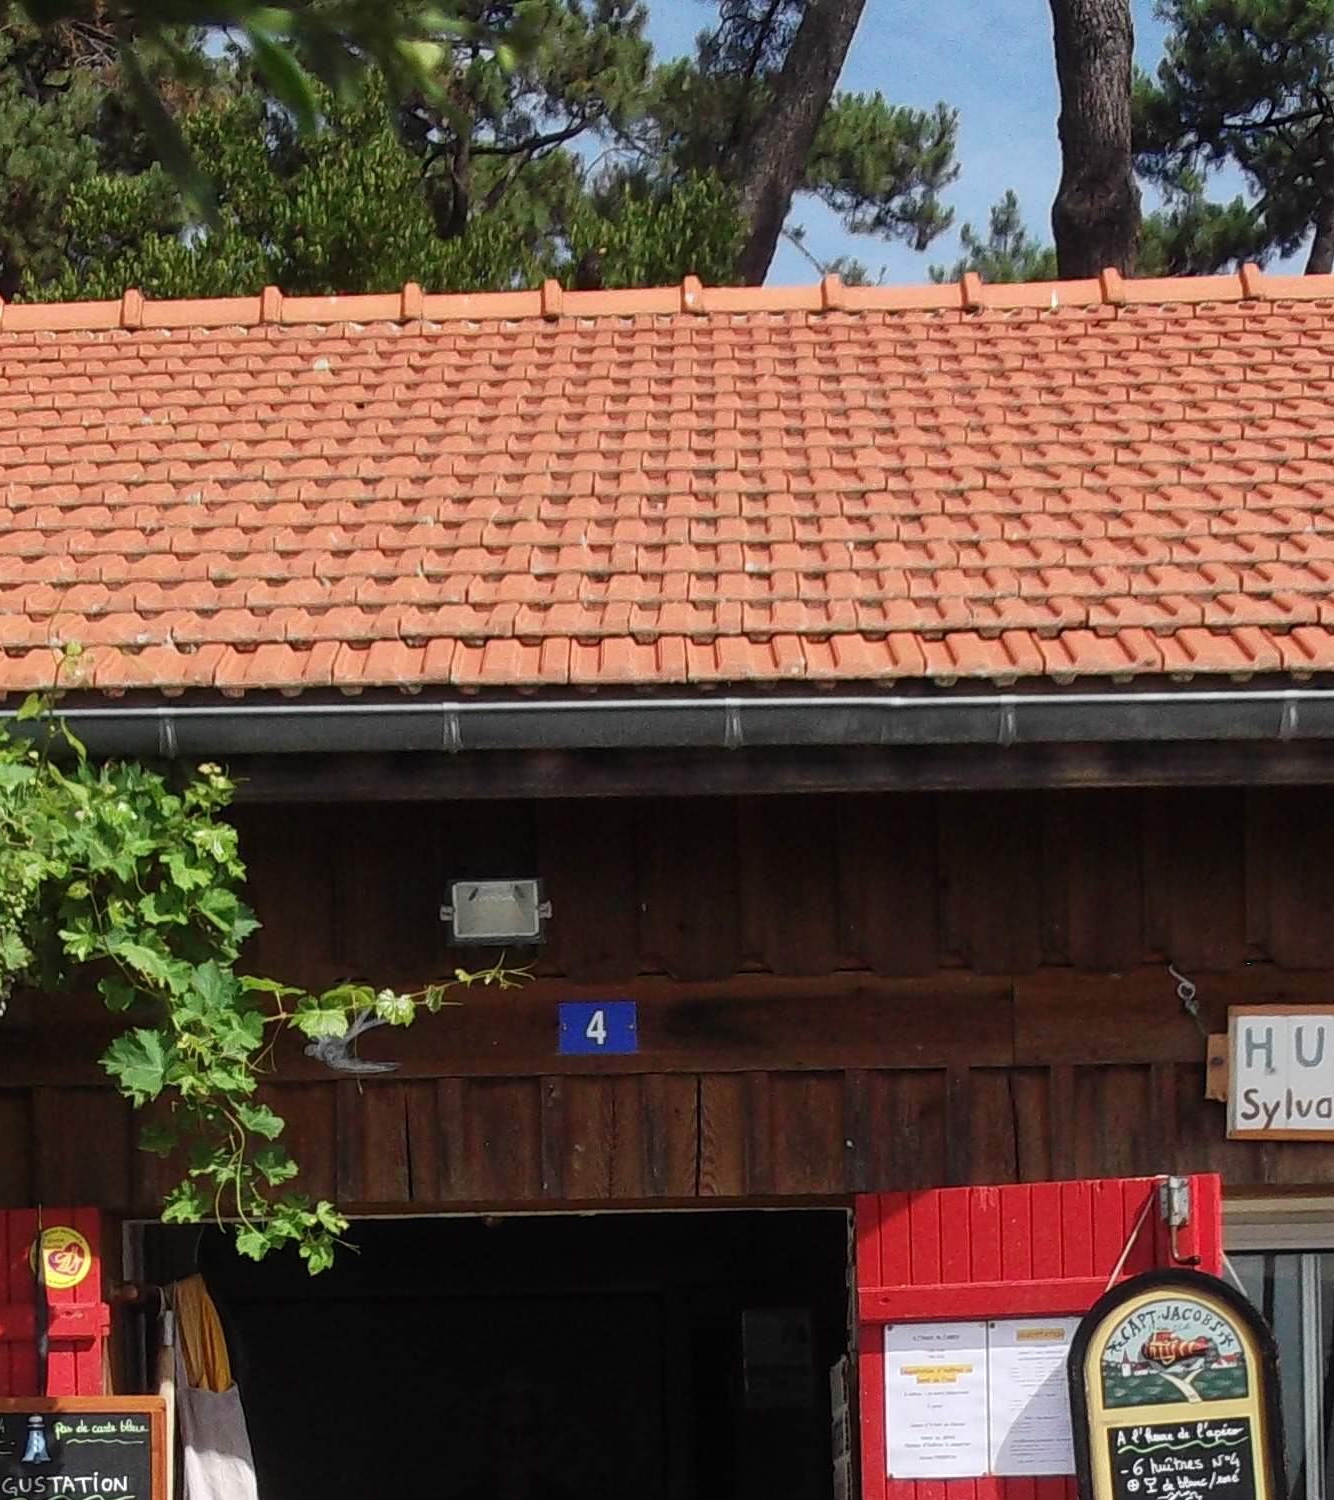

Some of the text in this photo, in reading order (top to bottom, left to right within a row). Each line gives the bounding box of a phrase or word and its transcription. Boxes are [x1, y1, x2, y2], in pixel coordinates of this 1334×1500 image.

[586, 1010, 607, 1045] 4
[1161, 1305, 1226, 1332] JACOBS
[75, 1419, 90, 1433] de
[1177, 1426, 1190, 1439] de
[1132, 1458, 1144, 1475] 6
